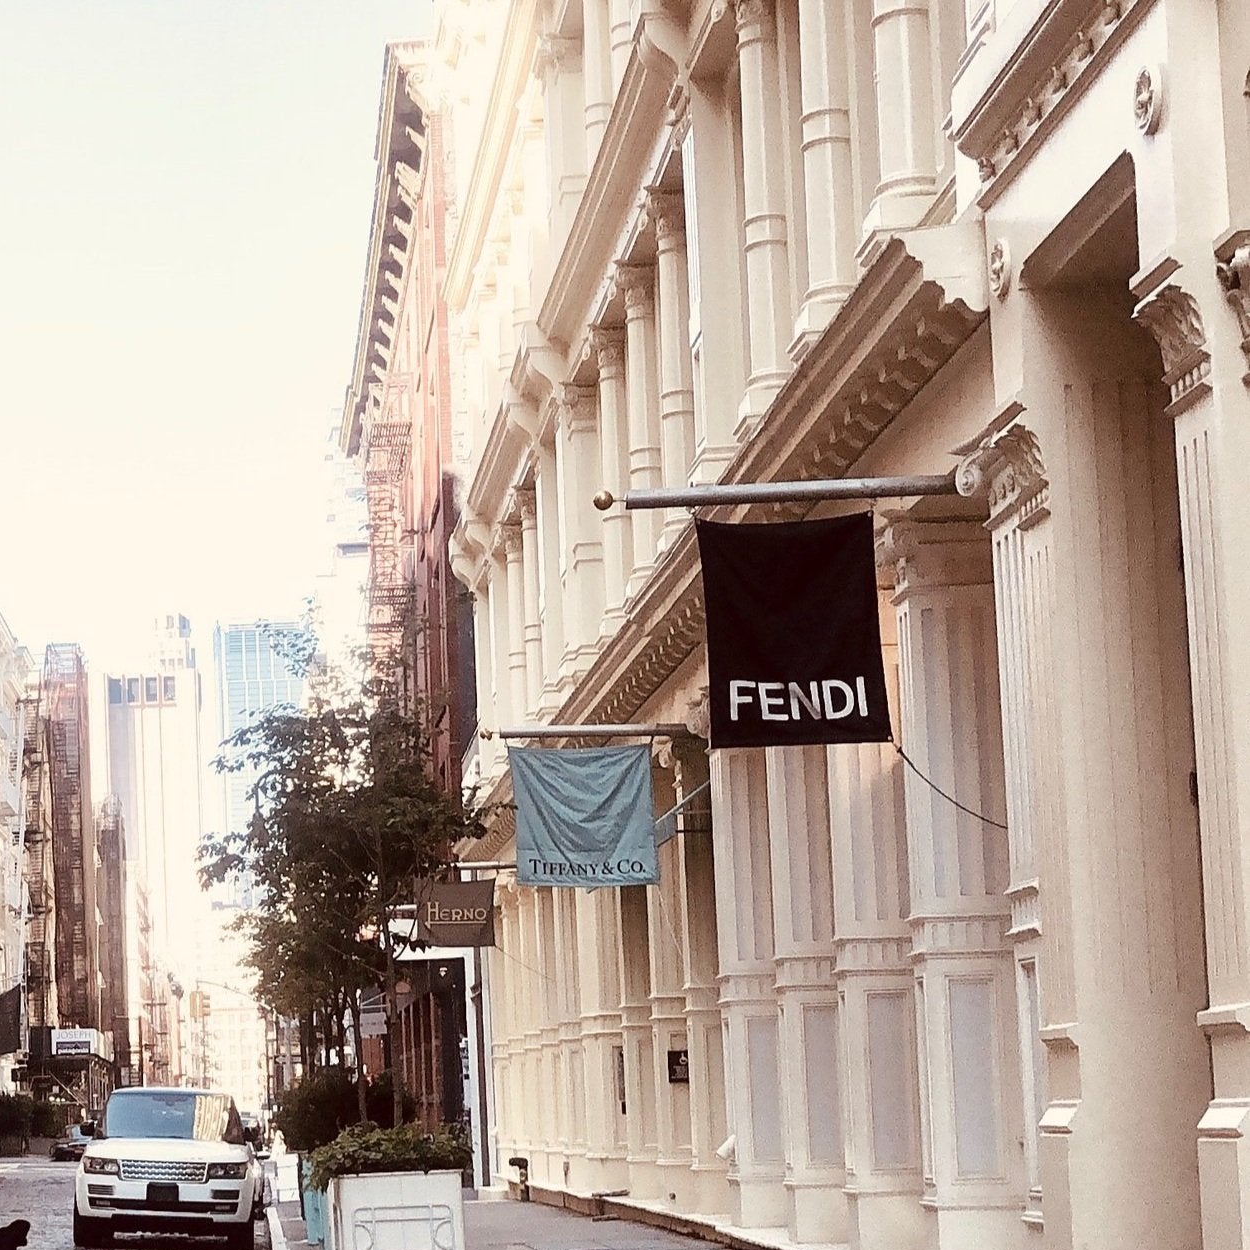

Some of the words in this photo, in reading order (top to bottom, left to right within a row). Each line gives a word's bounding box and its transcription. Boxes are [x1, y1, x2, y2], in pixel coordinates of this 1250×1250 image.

[729, 676, 869, 721] FENDI
[529, 858, 599, 875] TIFFANY
[601, 862, 615, 875] &
[427, 902, 487, 922] HERNO
[56, 1030, 91, 1040] JOSEPH
